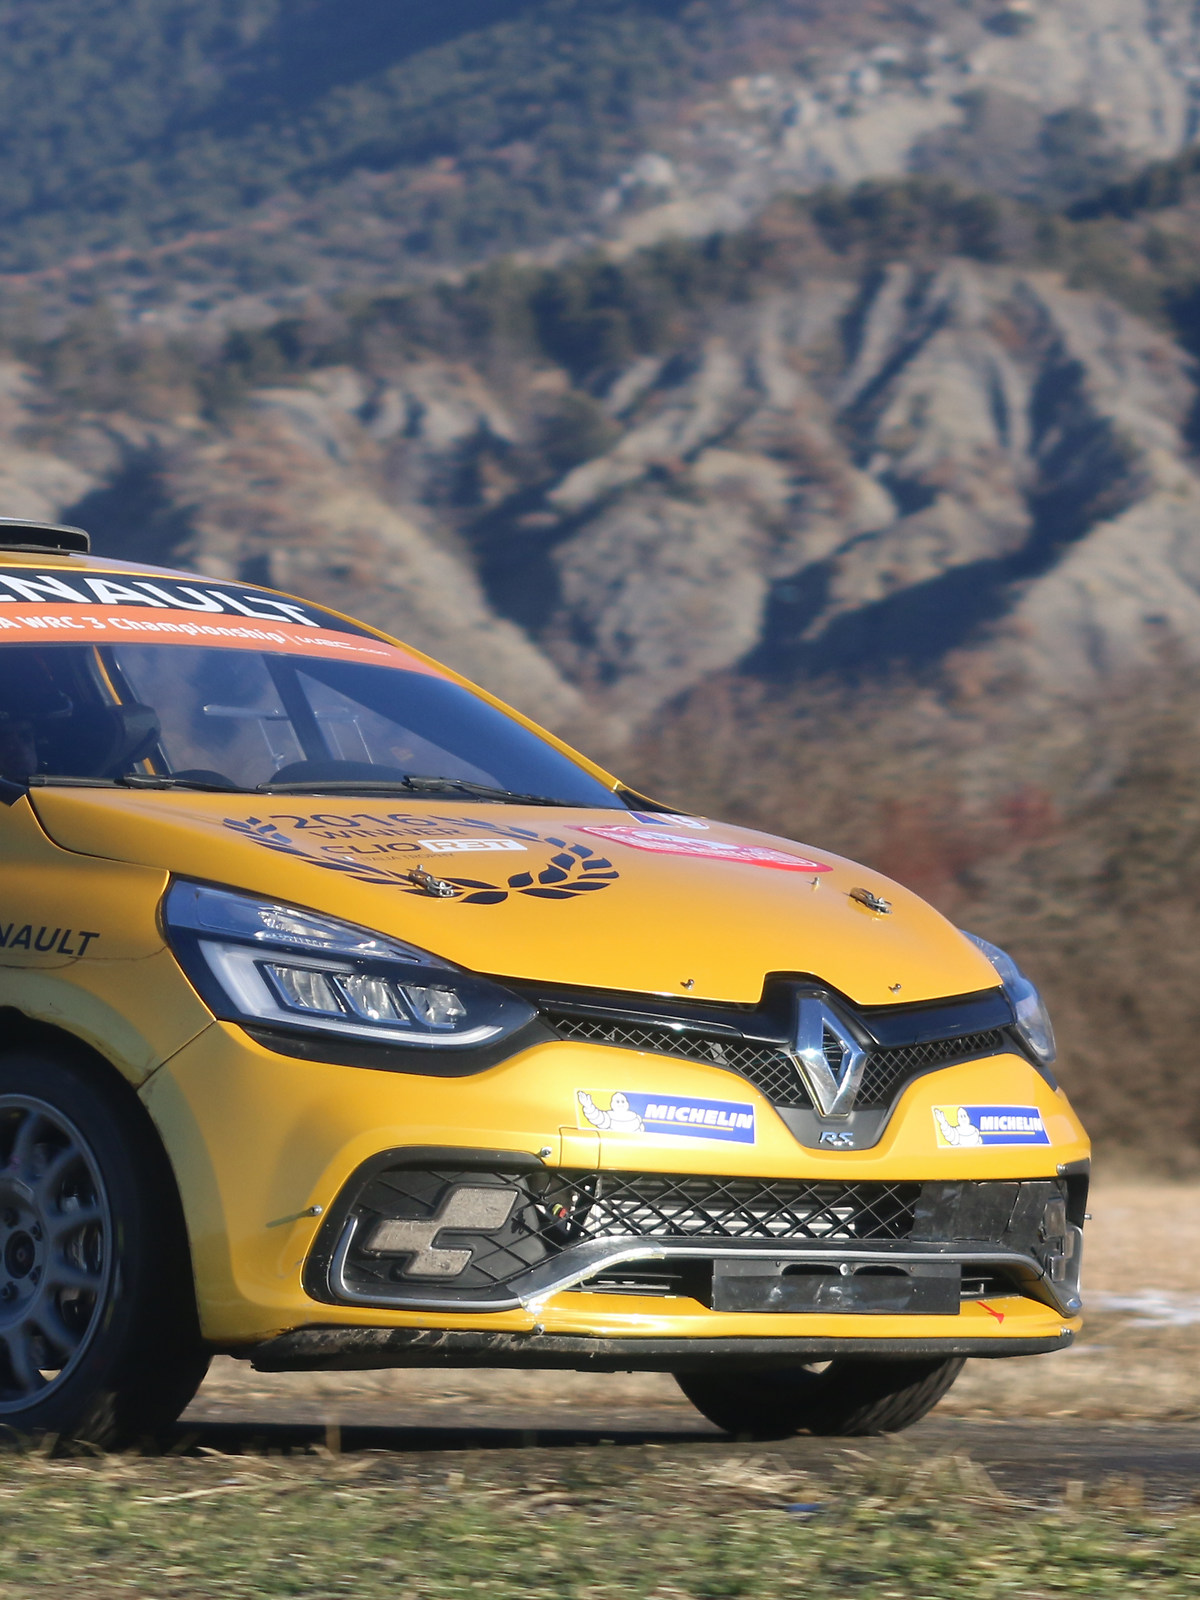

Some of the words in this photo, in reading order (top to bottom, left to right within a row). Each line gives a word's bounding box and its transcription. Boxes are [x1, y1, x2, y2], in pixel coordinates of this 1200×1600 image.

[15, 616, 86, 630] WRC
[81, 616, 107, 630] 3
[107, 617, 286, 644] Championship
[268, 813, 439, 829] 2016
[308, 825, 469, 840] WINNER
[321, 842, 421, 855] CLIO
[644, 1103, 754, 1130] MICHELIN
[979, 1115, 1043, 1132] MICHELIN
